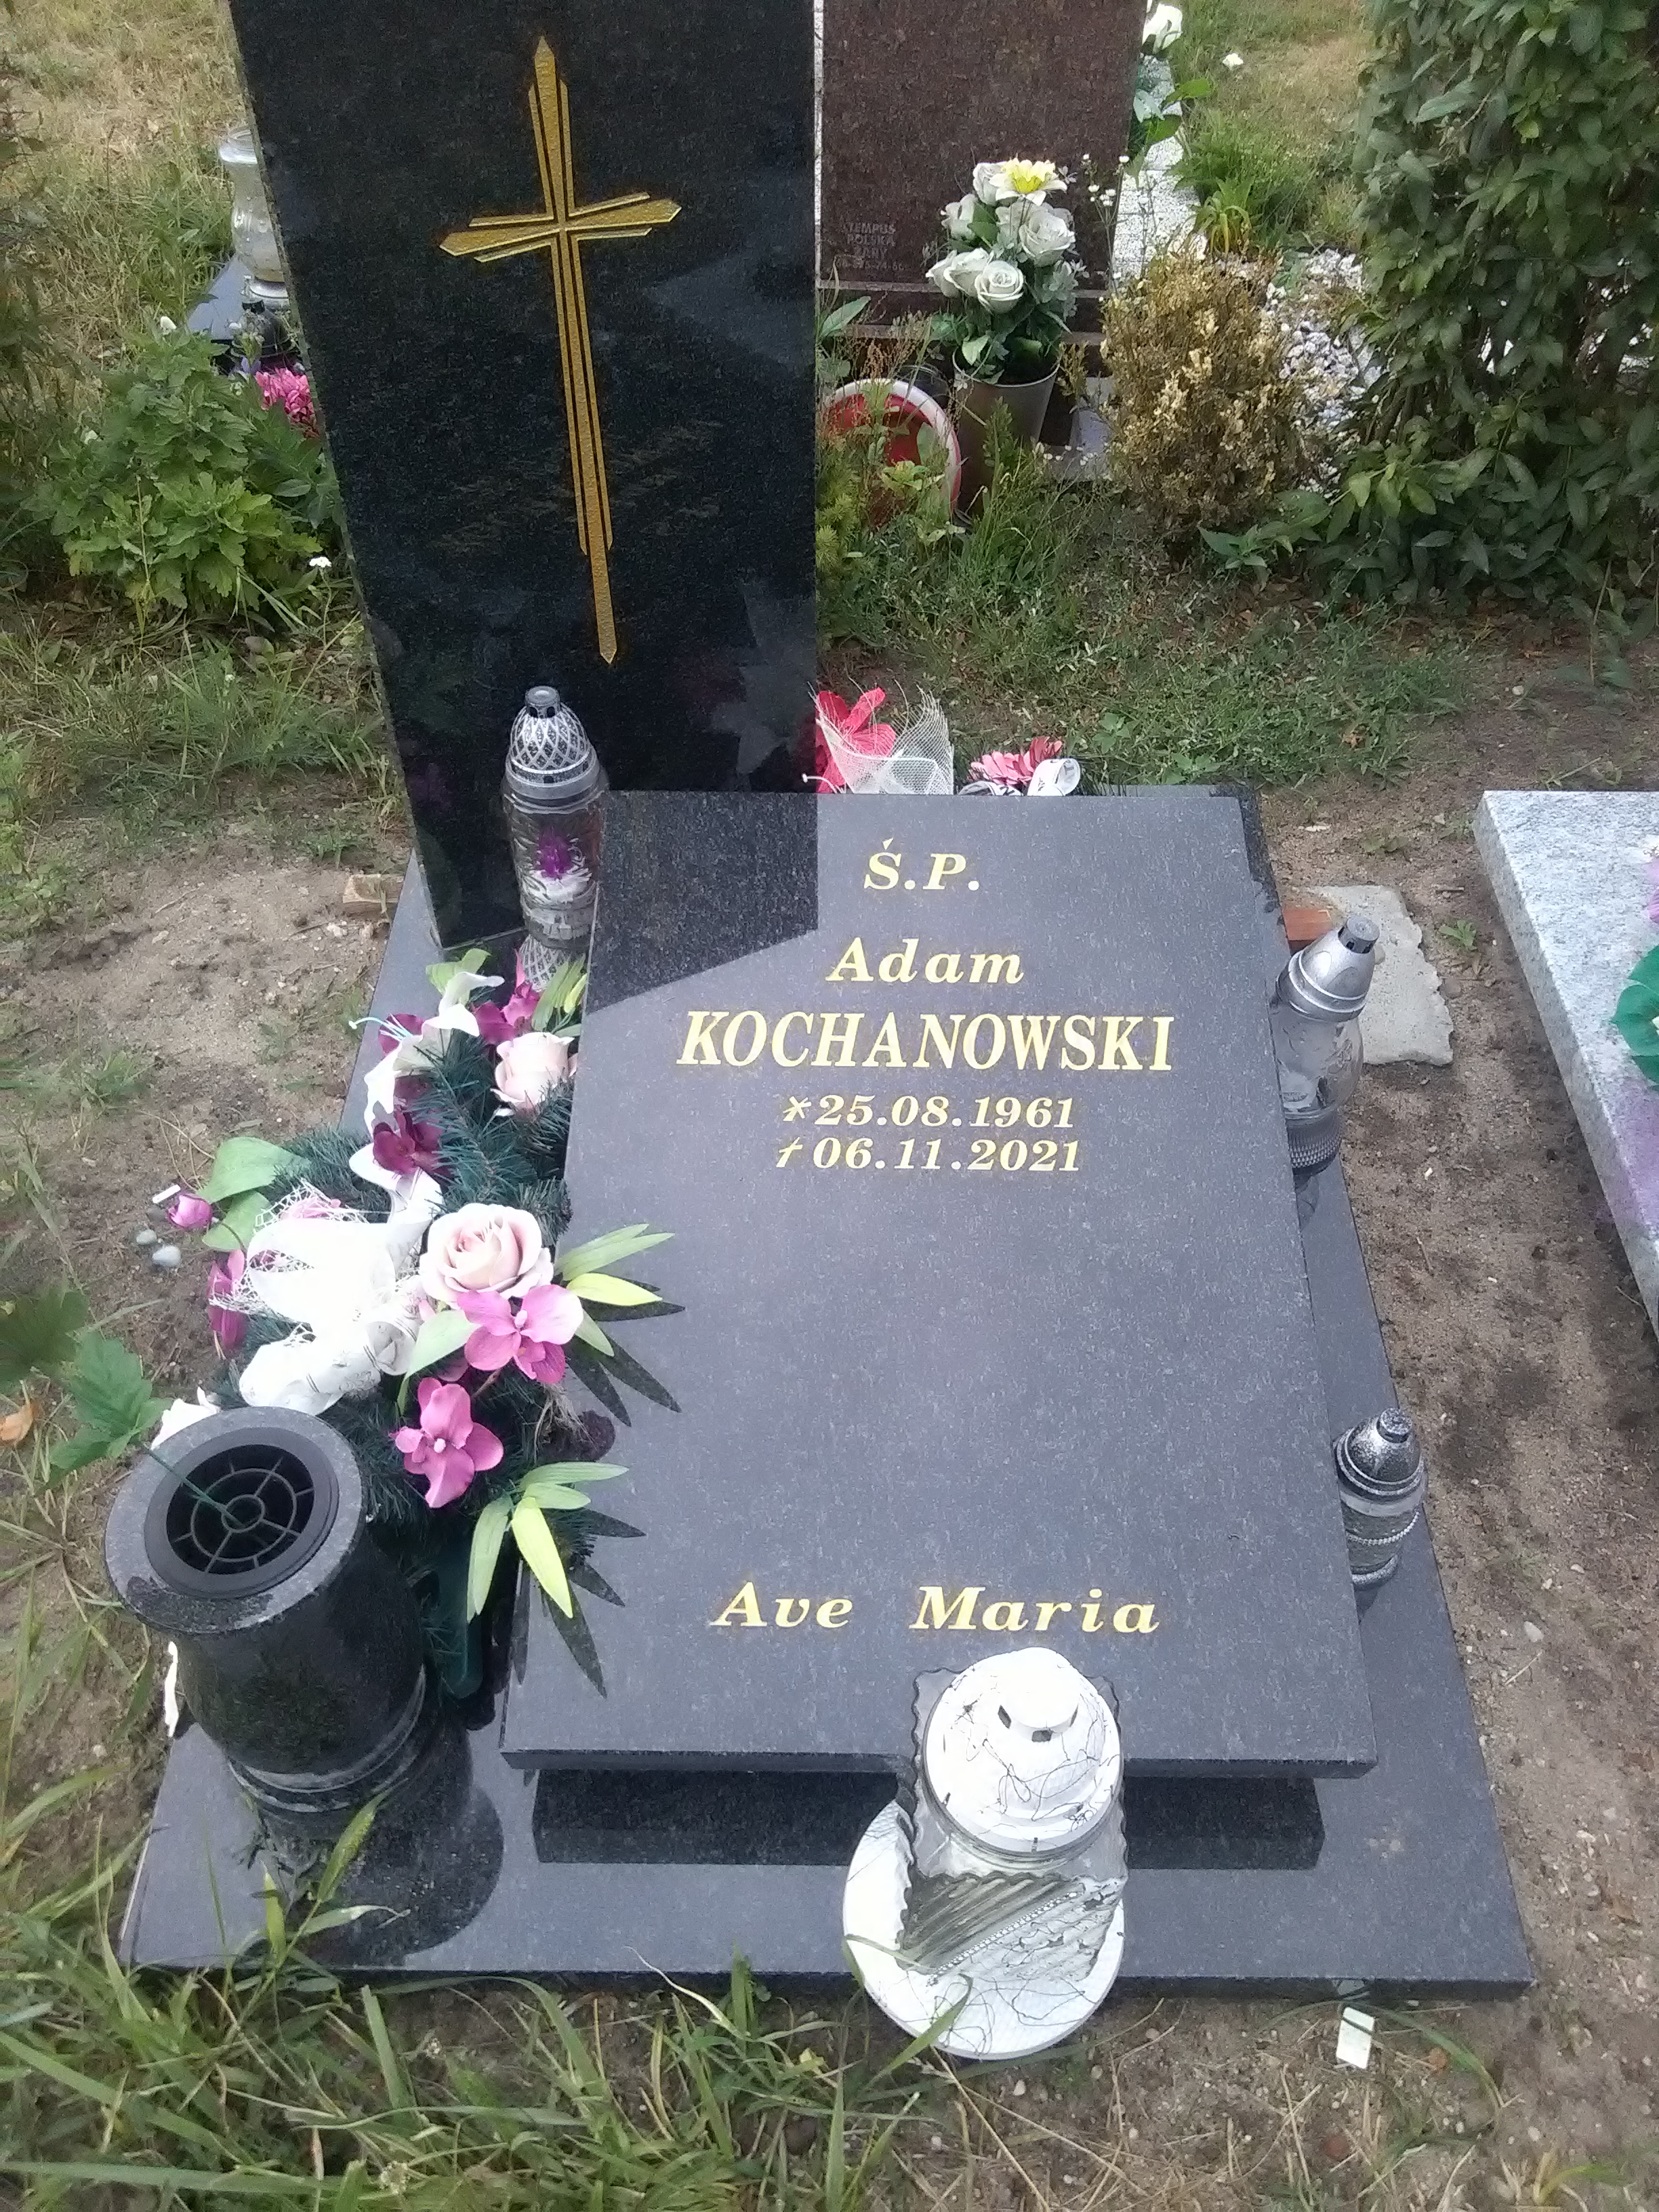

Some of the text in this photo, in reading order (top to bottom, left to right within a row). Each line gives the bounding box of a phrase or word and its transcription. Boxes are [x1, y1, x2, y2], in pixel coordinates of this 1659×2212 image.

[863, 838, 981, 891] Ś.P.
[825, 937, 1025, 984] Adam
[676, 1010, 1175, 1071] KOCHANOWSKI
[710, 1582, 1160, 1634] Ave Maria
